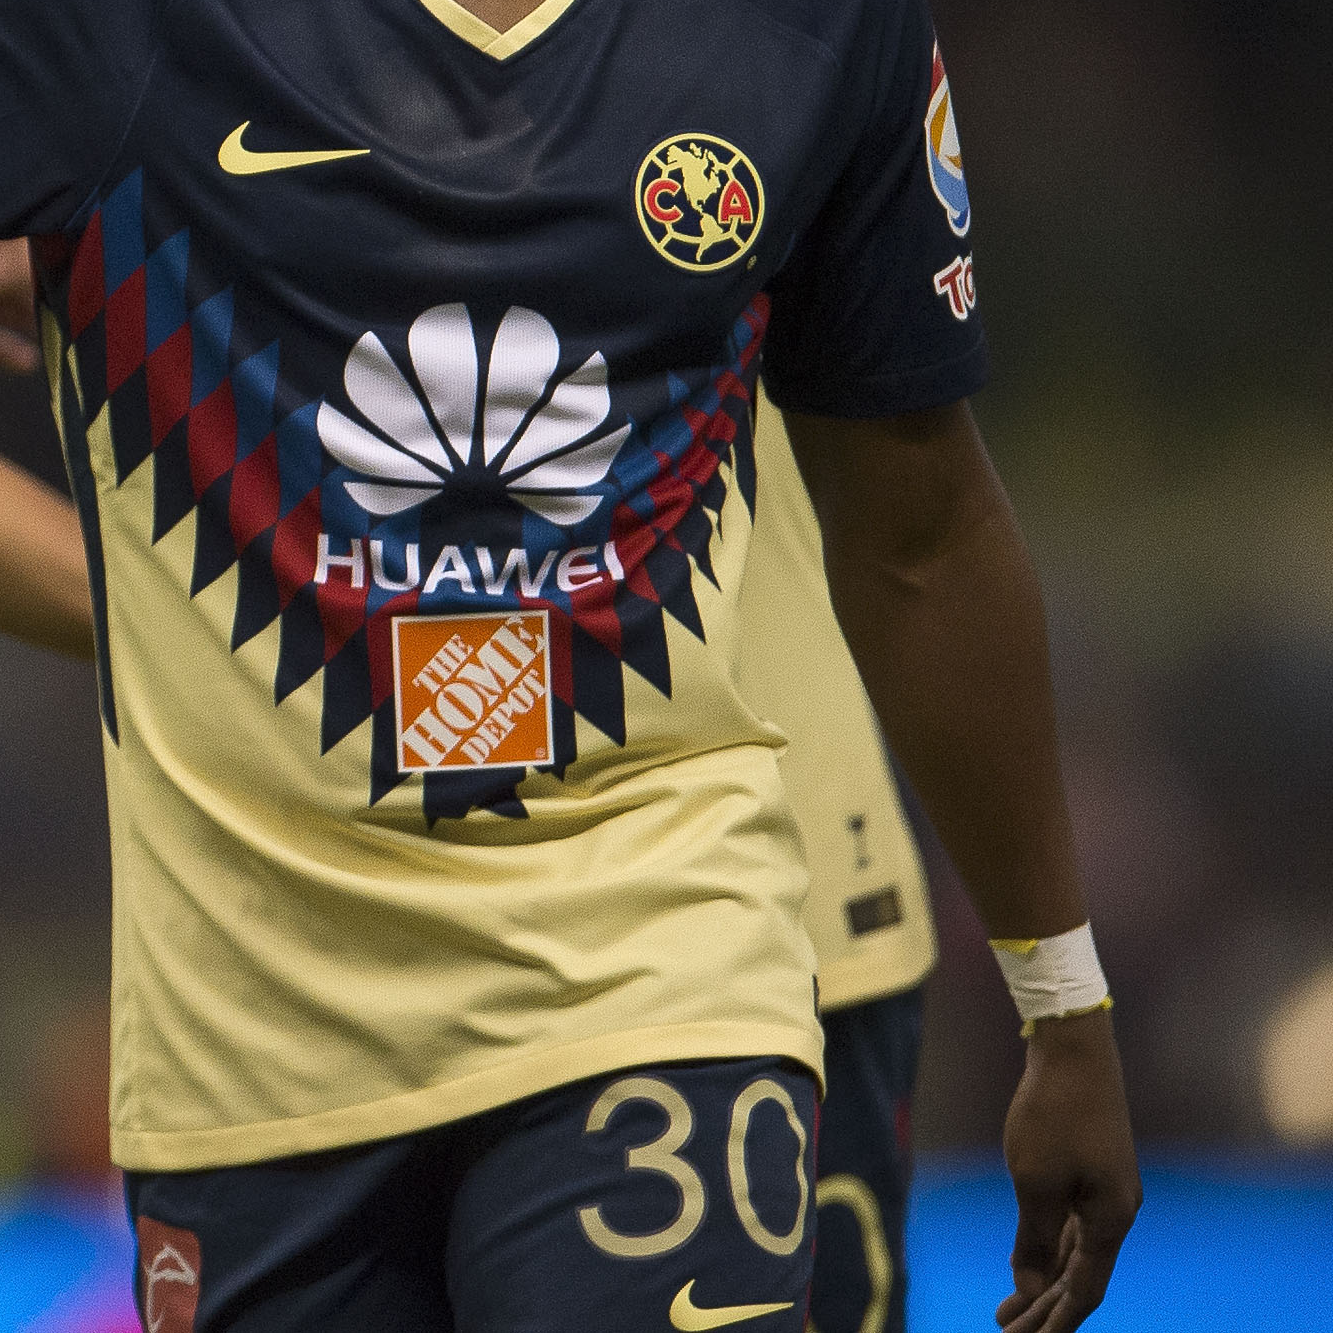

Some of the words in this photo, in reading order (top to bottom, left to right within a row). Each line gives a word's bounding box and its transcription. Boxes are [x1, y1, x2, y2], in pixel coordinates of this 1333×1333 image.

[313, 532, 625, 598] HUAWEI
[400, 615, 547, 766] HOME
[411, 634, 474, 695] THE
[459, 670, 546, 765] DEPOT
[579, 1077, 808, 1256] 30
